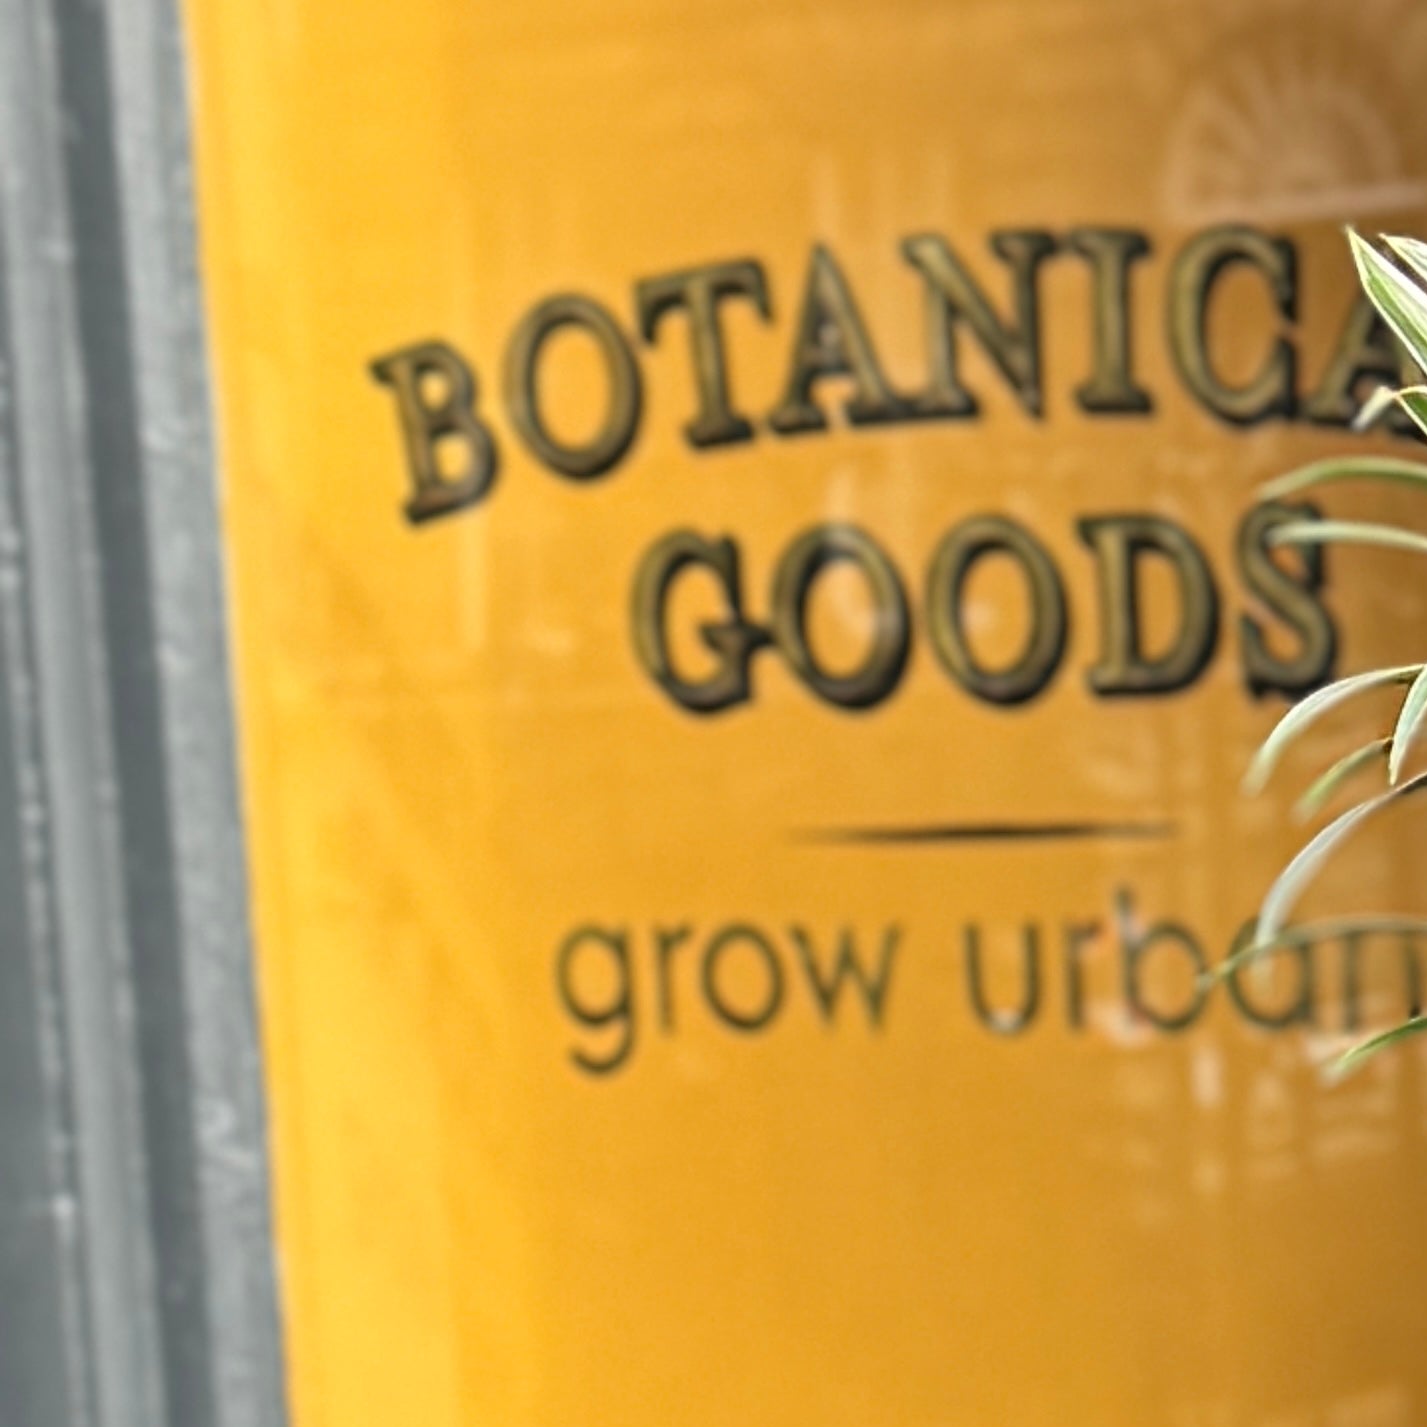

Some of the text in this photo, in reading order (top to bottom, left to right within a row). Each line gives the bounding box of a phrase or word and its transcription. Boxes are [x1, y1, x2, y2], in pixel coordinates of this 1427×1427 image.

[630, 501, 1338, 714] GOODS
[555, 885, 1425, 1074] grow urban
